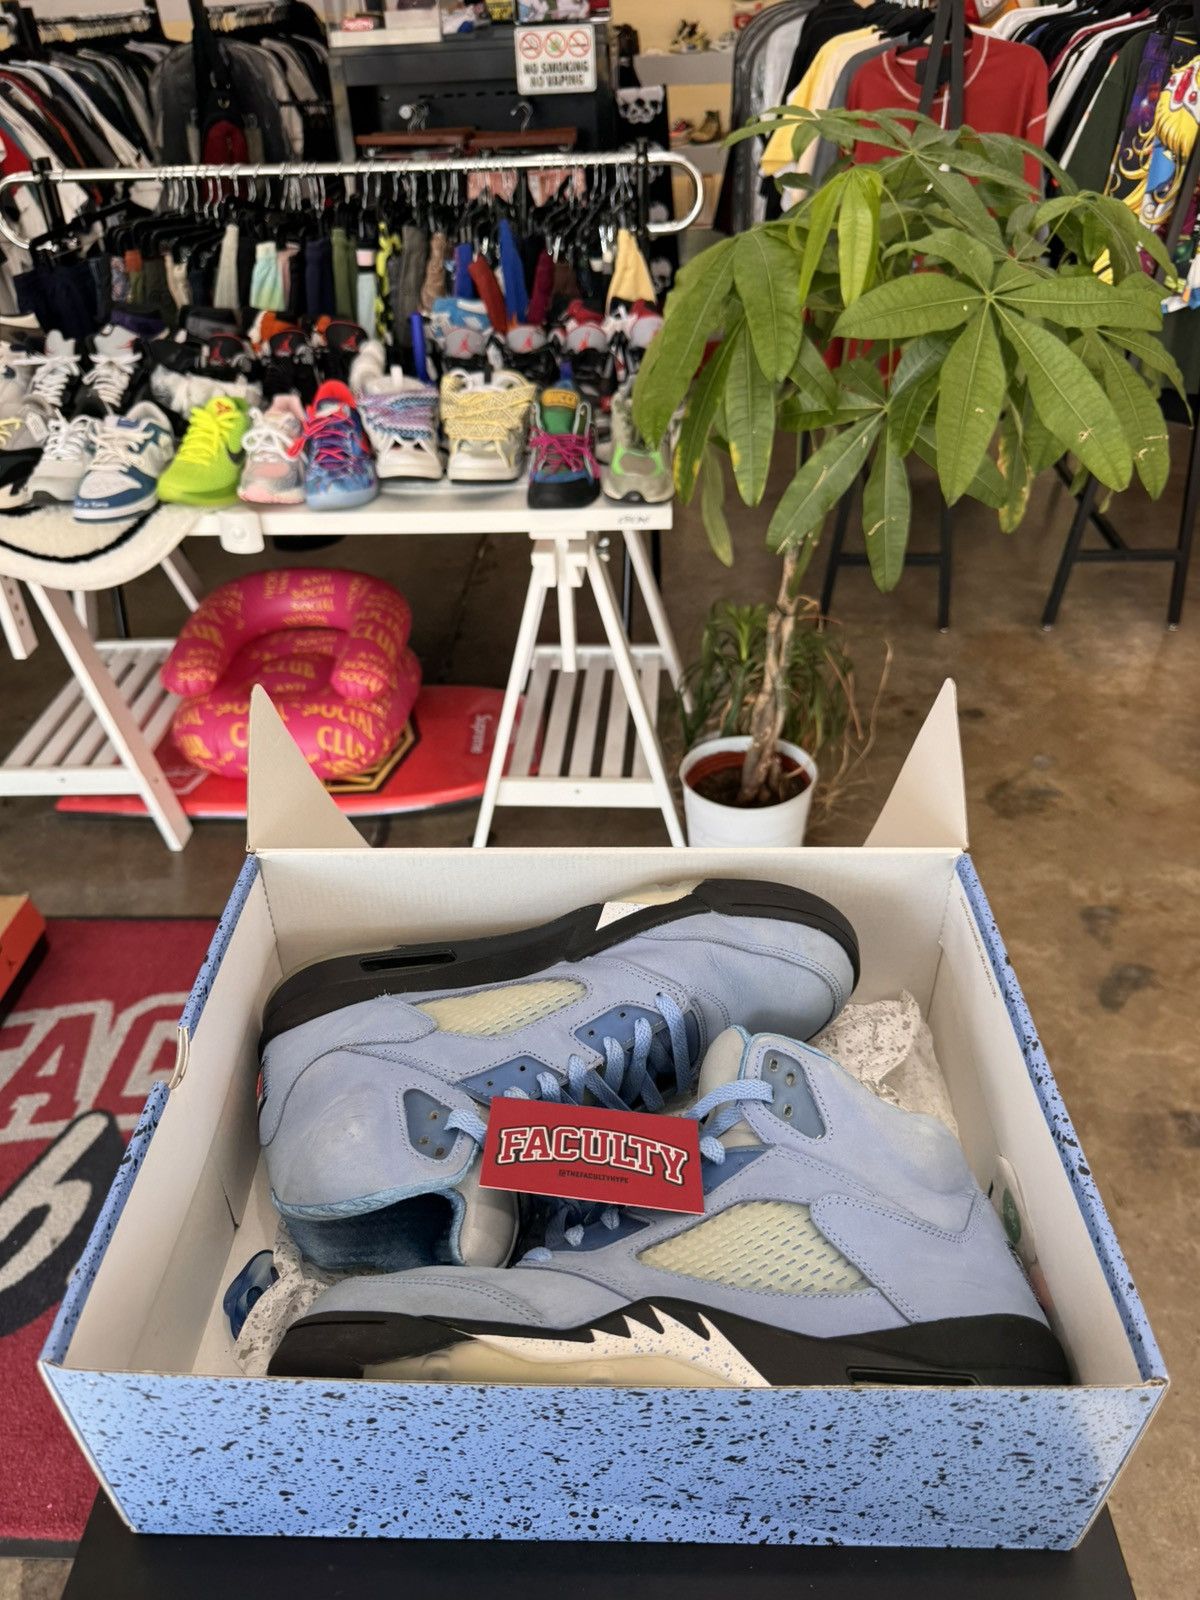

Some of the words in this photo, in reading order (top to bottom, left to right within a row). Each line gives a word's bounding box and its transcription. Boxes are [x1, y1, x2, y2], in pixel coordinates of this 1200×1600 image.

[524, 63, 539, 75] NO
[541, 61, 588, 74] SMOKING
[530, 76, 545, 88] NO
[546, 74, 584, 88] VAPING
[497, 1125, 689, 1186] FACULTY
[558, 1168, 629, 1184] @THEFACULTYHYPE
